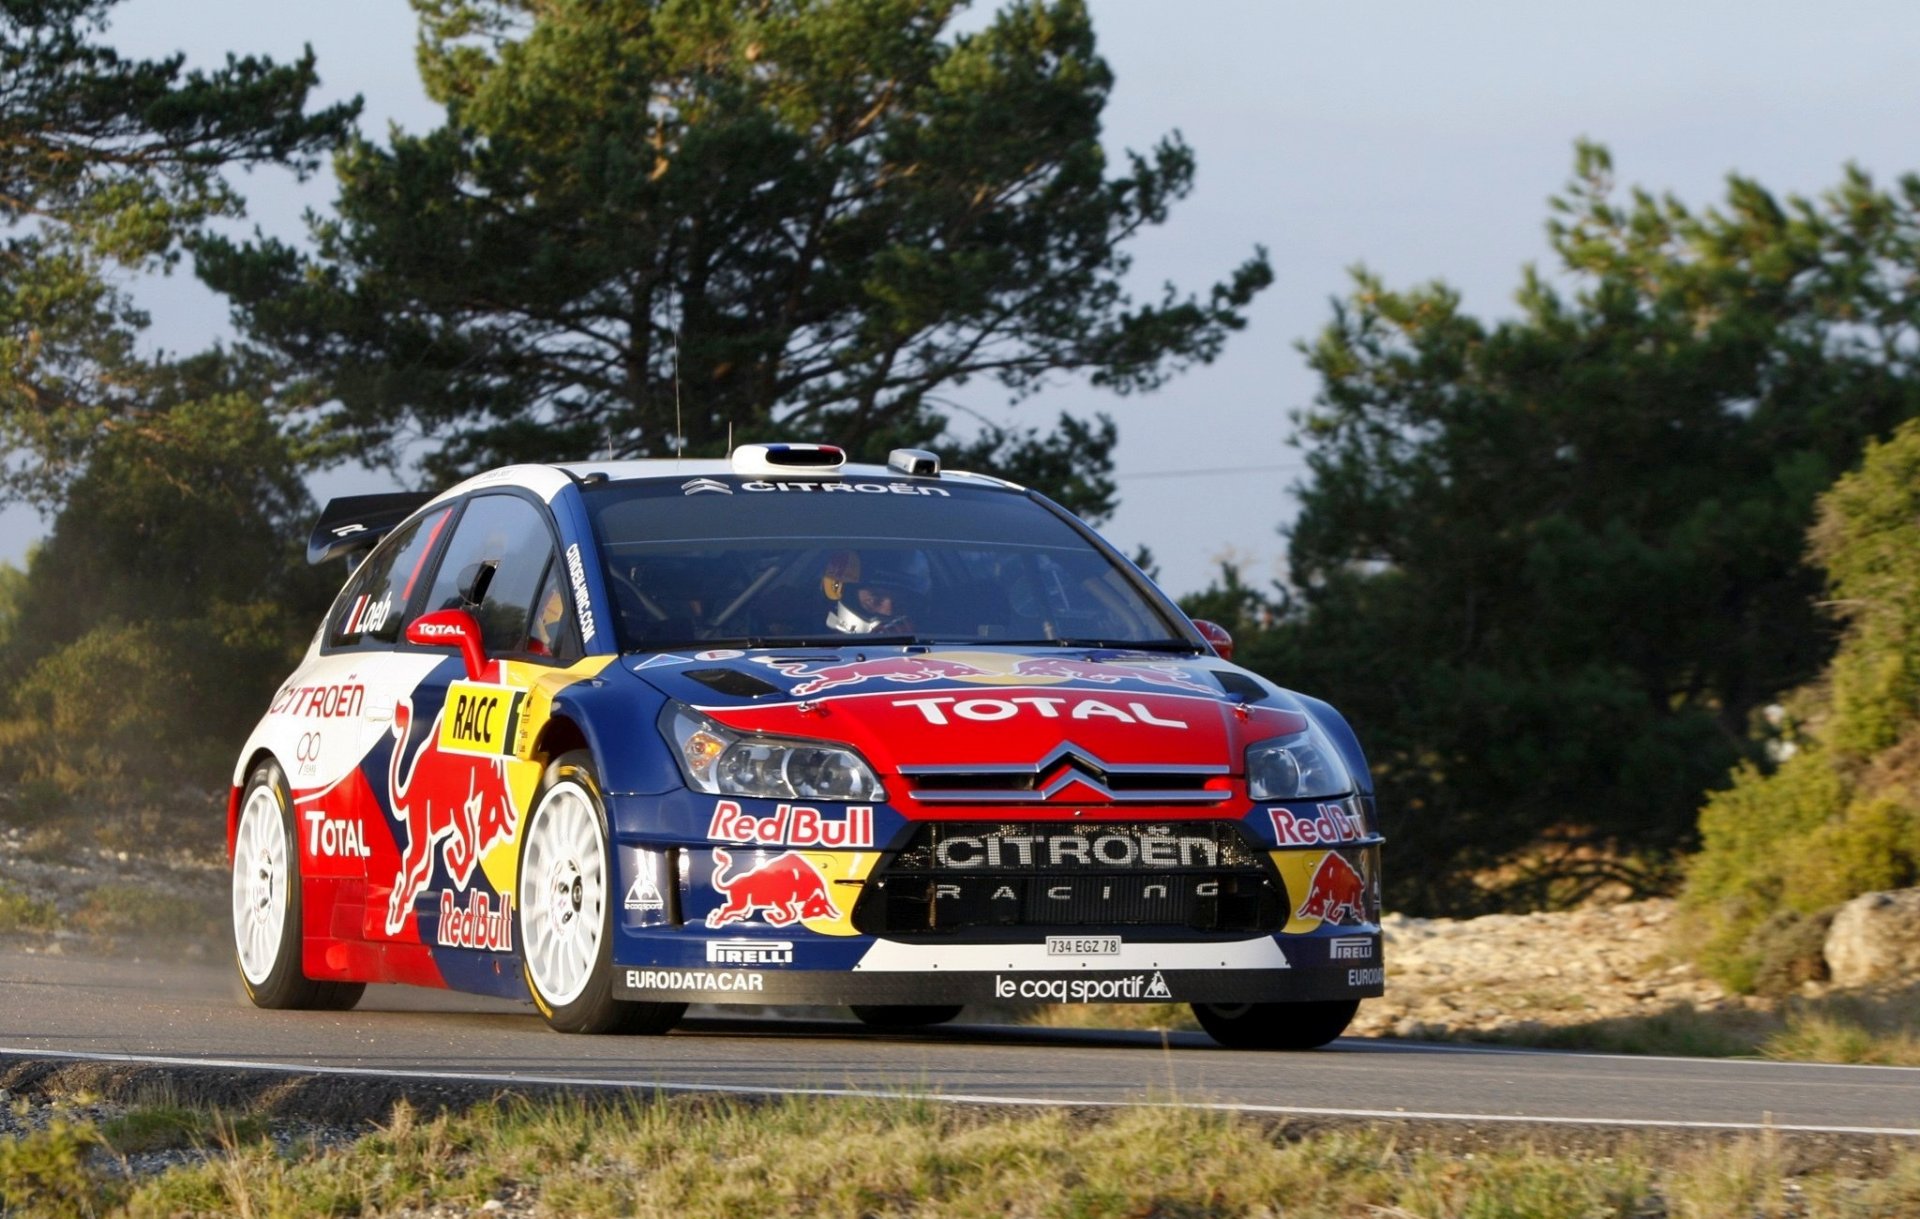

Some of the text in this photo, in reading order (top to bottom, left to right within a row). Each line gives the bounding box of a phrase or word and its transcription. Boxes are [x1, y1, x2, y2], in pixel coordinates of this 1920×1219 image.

[741, 481, 951, 497] CITROËN
[354, 591, 390, 634] Loeb
[418, 623, 466, 636] TOTAL
[452, 694, 498, 744] RACC
[891, 697, 1189, 729] TOTAL
[305, 810, 371, 857] TOTAL
[708, 800, 873, 846] Red Bull
[1267, 803, 1339, 845] Red
[936, 825, 1217, 867] CITROËN
[438, 888, 476, 947] Red
[475, 891, 512, 951] Bull
[706, 941, 793, 963] PIRELLI
[1051, 940, 1117, 953] 734 EGZ 78
[1330, 937, 1372, 959] PIRELLI
[626, 970, 764, 991] EURODATACAR
[995, 975, 1144, 1003] le coq sportif
